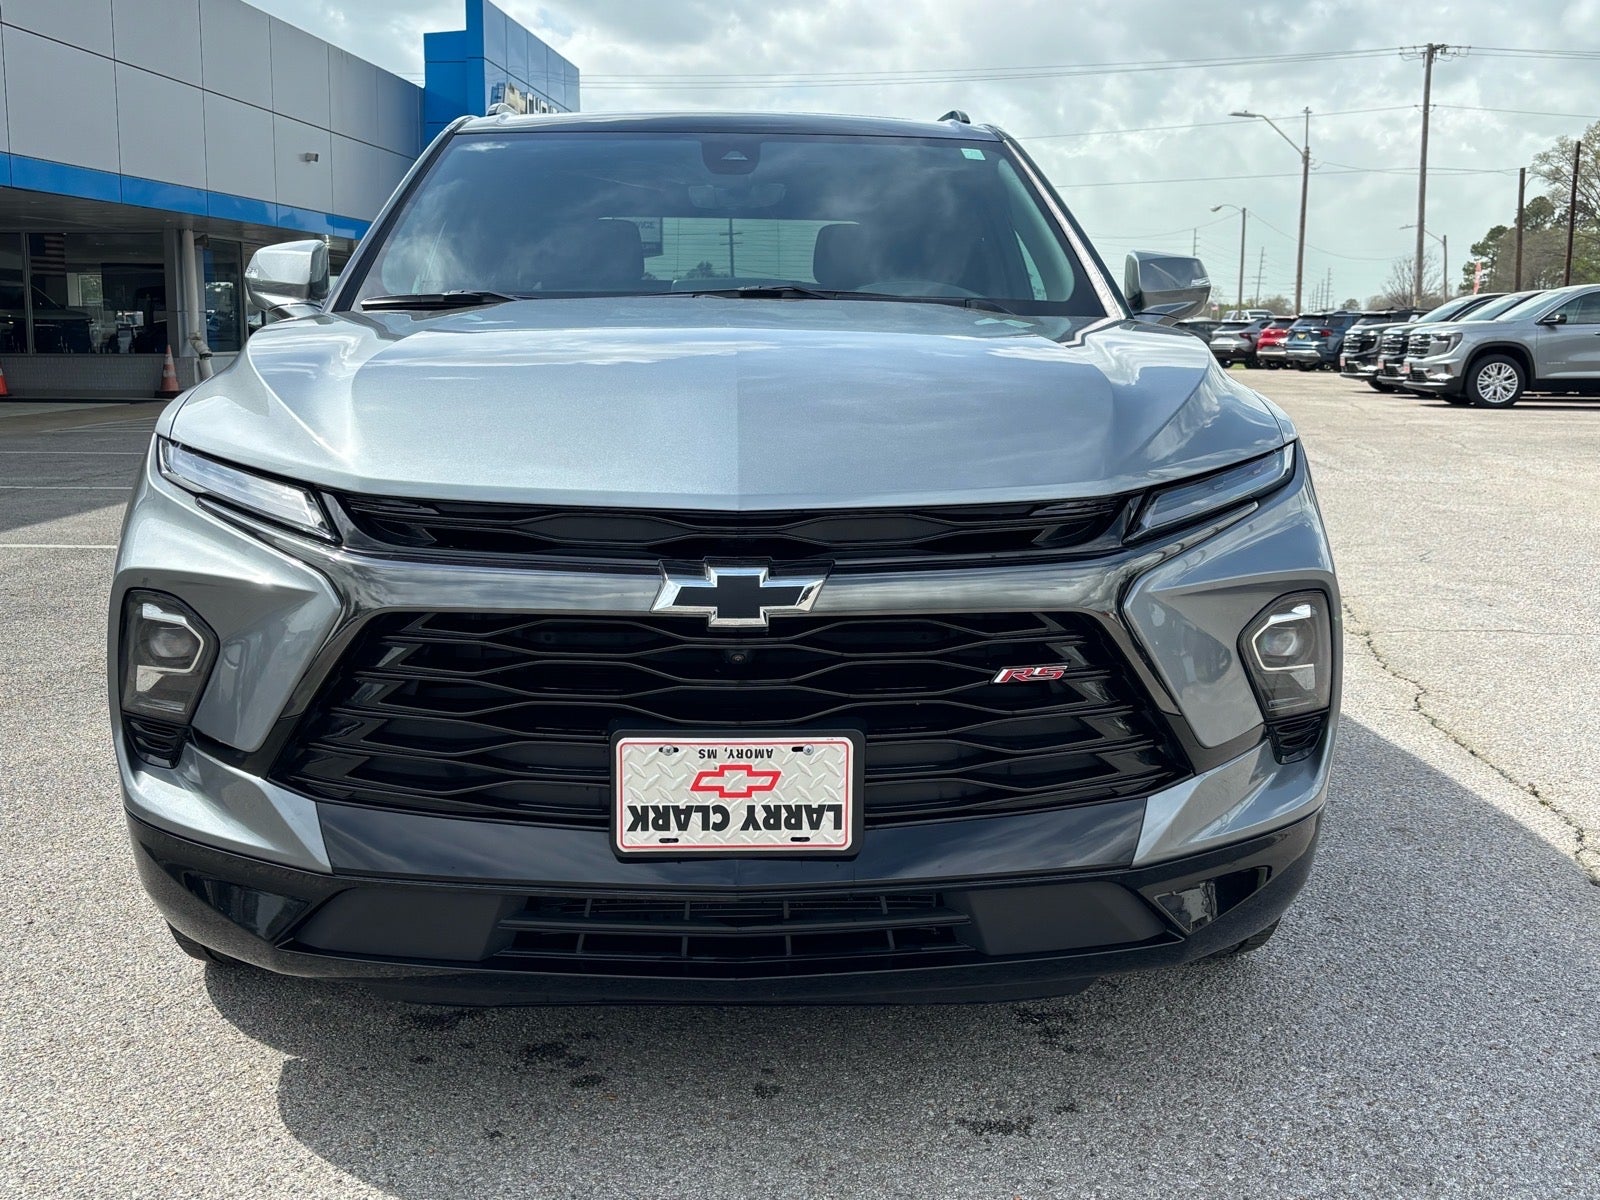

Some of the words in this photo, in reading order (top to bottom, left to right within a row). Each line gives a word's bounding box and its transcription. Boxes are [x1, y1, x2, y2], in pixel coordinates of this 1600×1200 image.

[993, 665, 1068, 684] RS
[698, 748, 718, 759] MS
[725, 747, 774, 759] AMORY,
[627, 804, 732, 832] CLARK
[740, 804, 843, 831] LARRY
